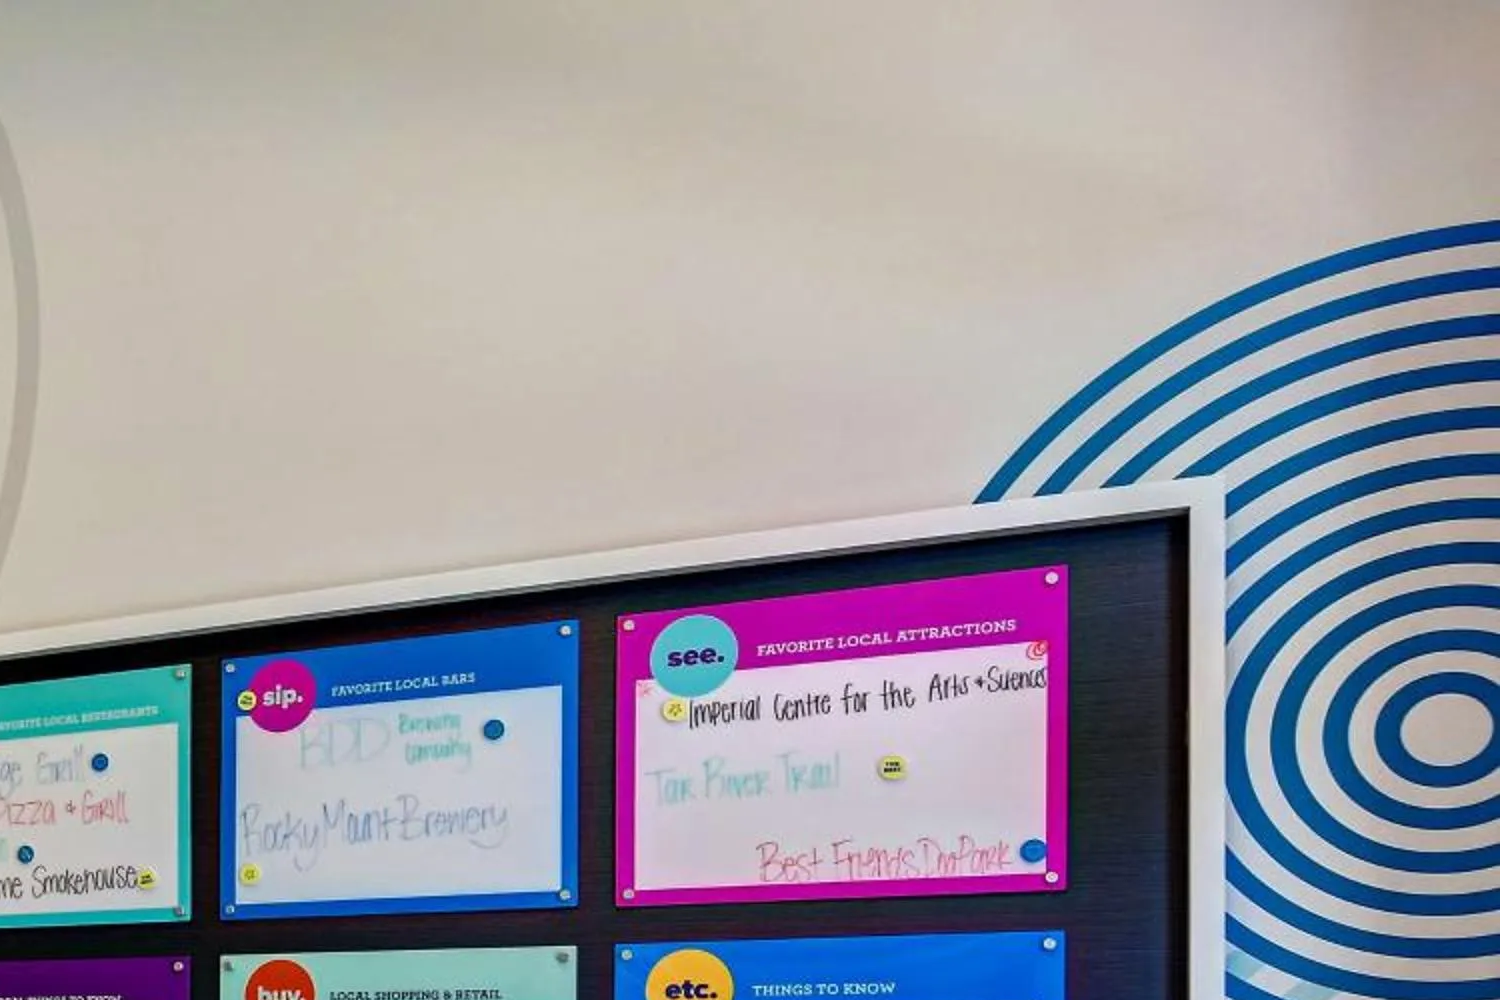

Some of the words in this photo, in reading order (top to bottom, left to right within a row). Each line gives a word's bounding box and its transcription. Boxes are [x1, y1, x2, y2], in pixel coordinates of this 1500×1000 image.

[756, 636, 836, 657] FAVORITE
[838, 630, 893, 649] LOCAL
[896, 619, 1017, 644] ATTRACTIONS
[667, 650, 725, 669] see.
[263, 684, 303, 709] sip.
[331, 678, 393, 697] FAVORITE
[395, 676, 439, 691] LOCAL
[442, 672, 476, 687] BARS
[688, 695, 761, 729] Imperial
[773, 693, 832, 723] Centre
[842, 684, 872, 716] for
[878, 679, 916, 711] the
[928, 672, 969, 702] Arts
[43, 714, 79, 728] LOCAL
[81, 705, 158, 722] RESTAURANTS
[756, 841, 825, 883] Best
[31, 865, 138, 900] Smokehouse
[374, 990, 440, 1000] SHOPPING
[443, 990, 452, 1000] &
[456, 989, 502, 1000] RETAIL
[665, 980, 718, 999] etc.
[752, 984, 813, 997] THINGS
[818, 983, 839, 995] TO
[843, 982, 896, 995] KNOW
